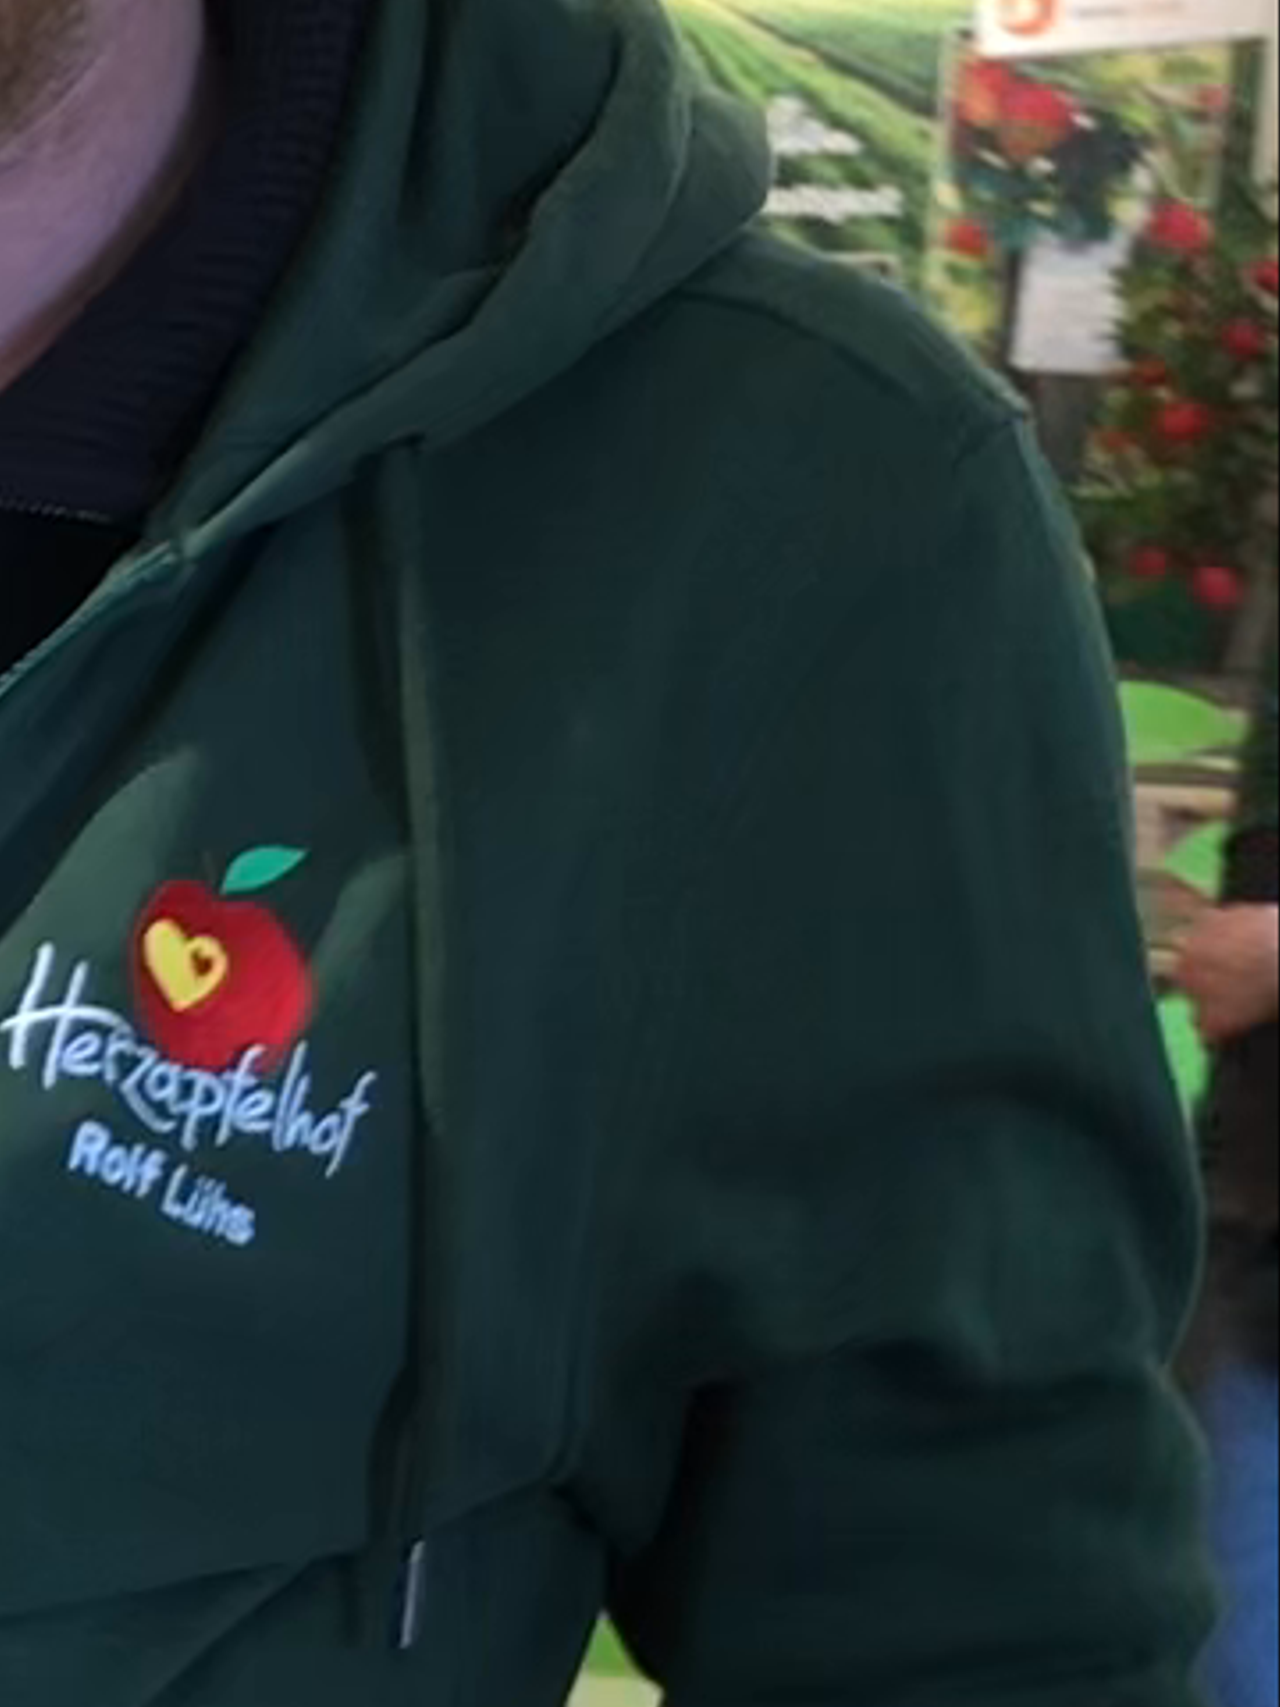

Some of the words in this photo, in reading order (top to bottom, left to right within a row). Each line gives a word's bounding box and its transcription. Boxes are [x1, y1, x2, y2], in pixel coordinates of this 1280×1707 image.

[0, 943, 377, 1178] Herzapfelhof
[68, 1121, 167, 1197] Rolf
[162, 1165, 255, 1245] Lühs
